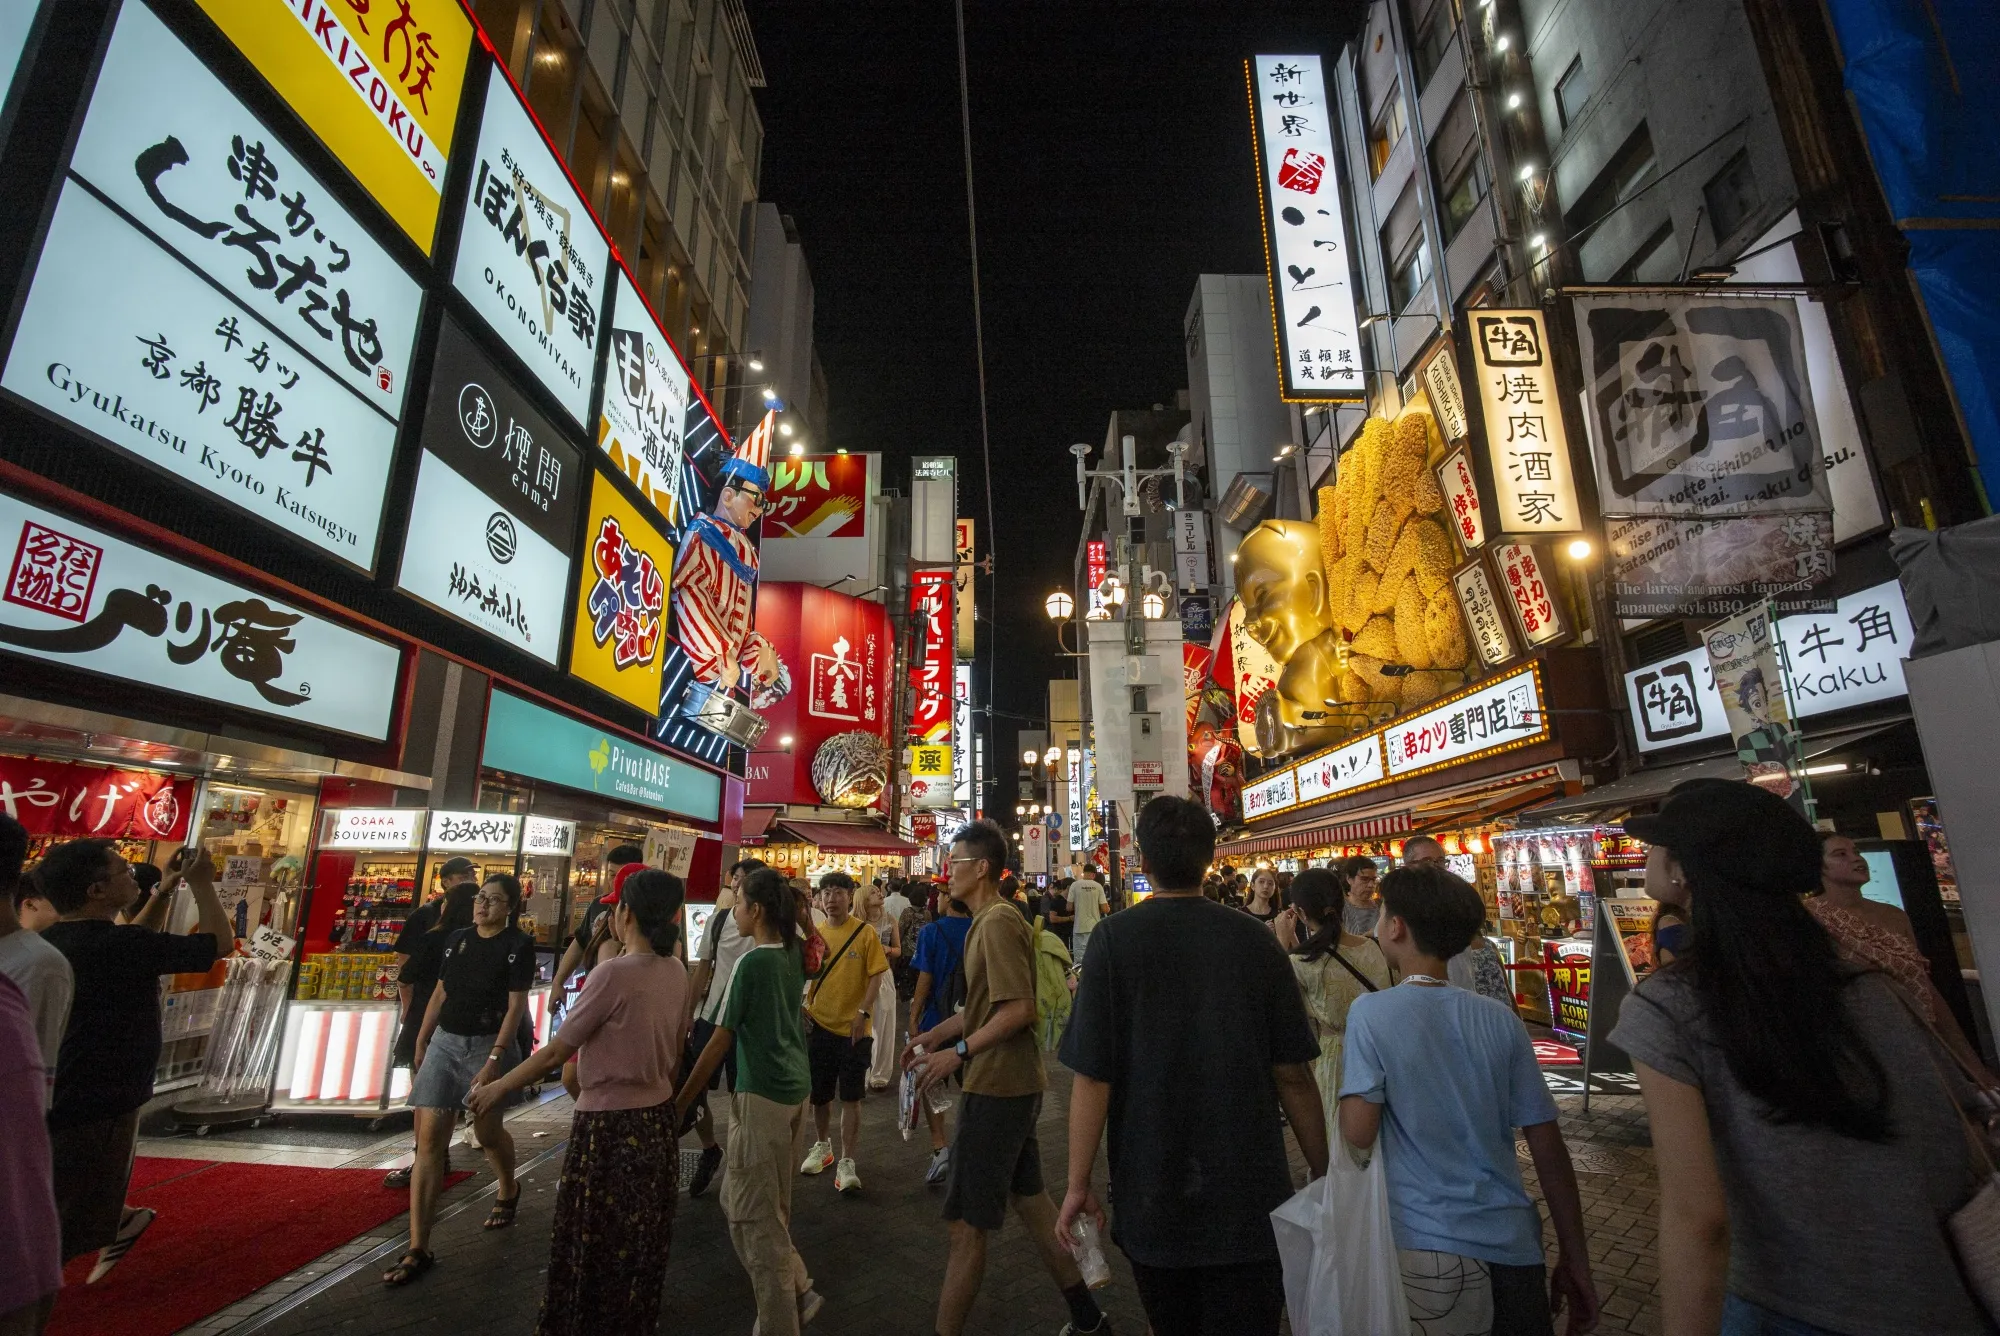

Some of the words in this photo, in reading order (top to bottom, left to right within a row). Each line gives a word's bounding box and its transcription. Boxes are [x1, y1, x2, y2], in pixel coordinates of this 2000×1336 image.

[292, 0, 423, 158] IKIZOKU
[1270, 63, 1316, 137] 新世界
[227, 134, 351, 273] 串かつ
[474, 159, 596, 350] ぼんくら家
[214, 317, 300, 390] 牛カツ
[484, 267, 581, 389] OKONOMIYAKI
[1298, 349, 1353, 363] 道頓堀
[1488, 325, 1536, 356] 牛角
[135, 333, 333, 488] 京都勝牛
[619, 332, 681, 454] もんじゃ
[1430, 363, 1462, 439] KUSHIKATSU
[1440, 355, 1452, 382] Osaka
[1450, 382, 1467, 422] specialty
[46, 362, 187, 455] Gyukatsu
[200, 444, 265, 496] Kyoto
[275, 486, 358, 547] Katsugyu
[641, 423, 675, 490] 酒場
[1496, 373, 1563, 525] 焼肉酒家
[1669, 480, 1706, 507] totte
[1780, 422, 1806, 446] no
[512, 475, 548, 511] enma
[18, 531, 61, 606] 名物
[48, 540, 94, 613] なにわ
[595, 519, 663, 610] あそび
[1520, 556, 1552, 624] 串カツ
[1615, 582, 1641, 595] The
[1708, 581, 1745, 594] most
[1751, 579, 1813, 594] famous
[1615, 602, 1675, 616] Japanese
[1679, 601, 1704, 615] style
[1708, 600, 1743, 615] BBQ
[1799, 604, 1898, 664] 牛角
[1402, 697, 1510, 760] 串カツ専門店
[1647, 682, 1693, 722] 牛角
[919, 750, 942, 772] 薬
[350, 816, 395, 826] OSAKA
[914, 816, 936, 824] ツルハ
[1070, 800, 1081, 845] かに道楽
[1249, 781, 1287, 811] 串カツ専門店
[333, 830, 408, 841] SOUVENIRS
[439, 817, 513, 844] おみやげ
[553, 825, 569, 849] 名物
